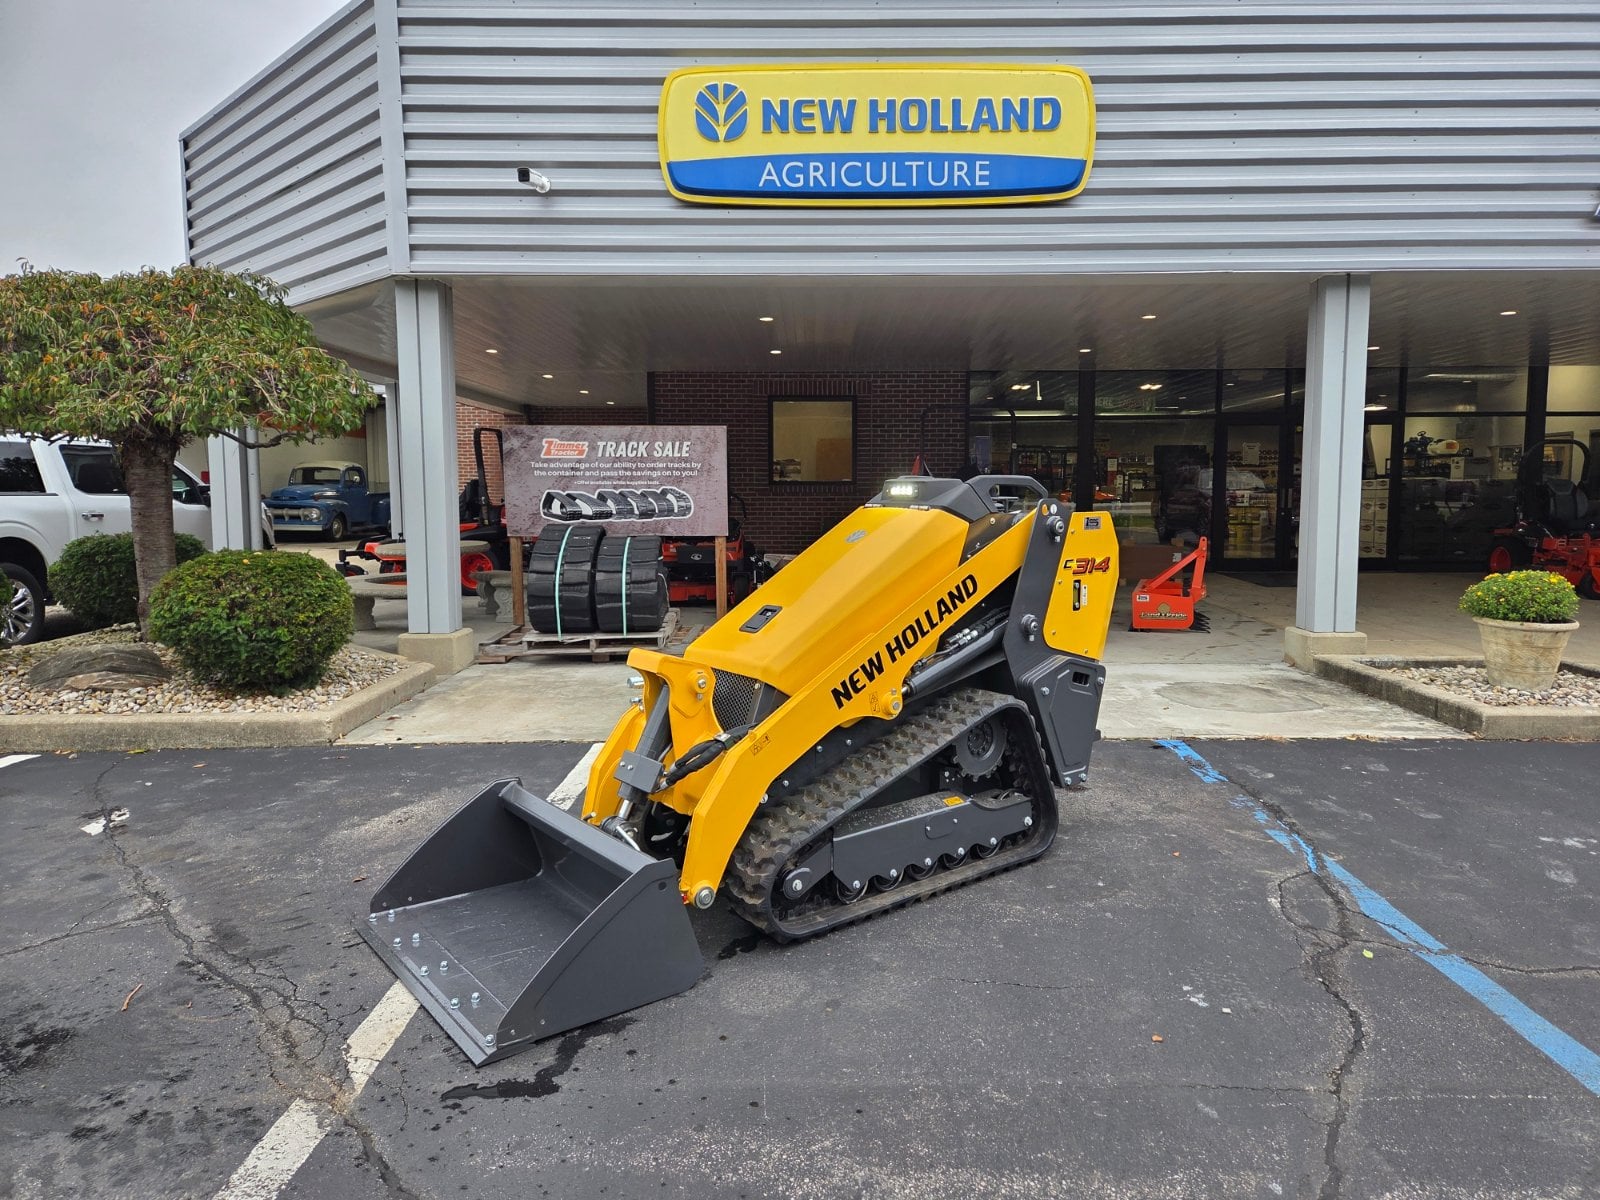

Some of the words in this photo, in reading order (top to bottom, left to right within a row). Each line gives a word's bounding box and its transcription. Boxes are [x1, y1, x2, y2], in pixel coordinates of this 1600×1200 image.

[761, 97, 857, 134] NEW
[868, 96, 1063, 133] HOLLAND
[758, 160, 990, 188] AGRICULTURE
[543, 439, 588, 457] Zimmer
[597, 441, 650, 458] TRACK
[653, 441, 692, 458] SALE
[549, 461, 590, 470] advantage
[613, 461, 637, 470] ability
[691, 461, 702, 470] by
[632, 470, 661, 478] savings
[681, 470, 698, 478] you!
[830, 650, 886, 710] NEW
[885, 573, 978, 664] HOLLAND
